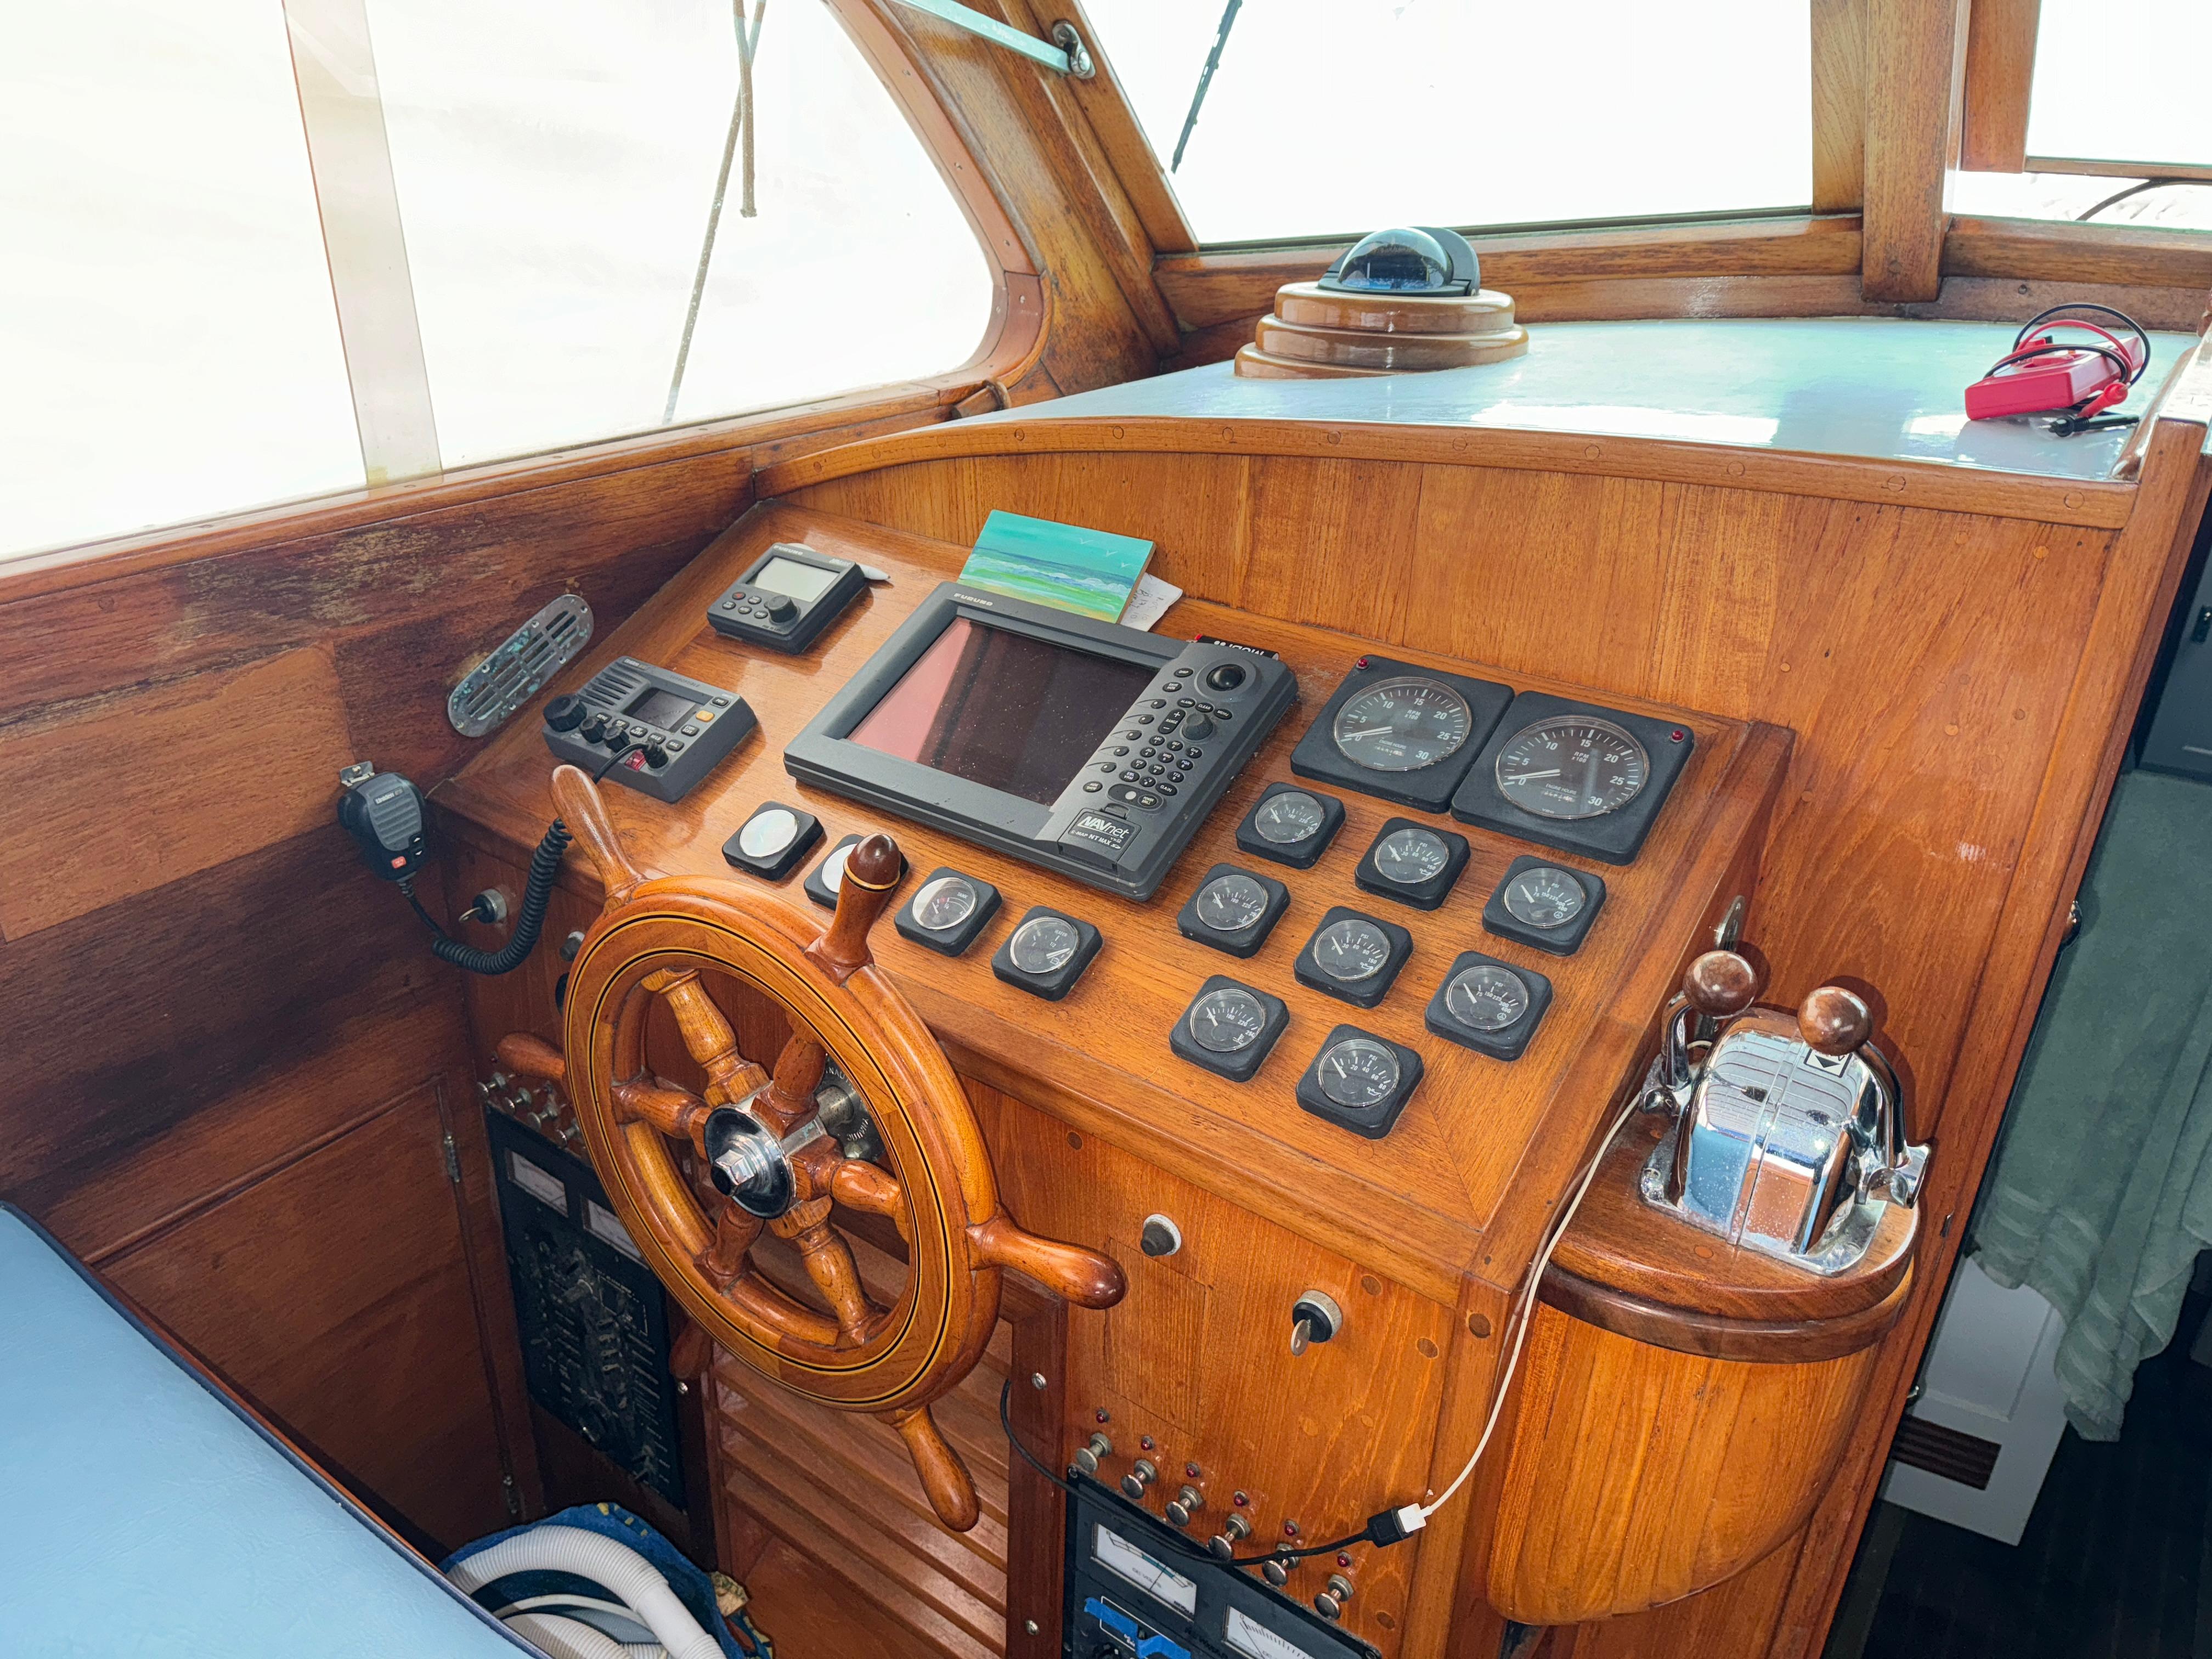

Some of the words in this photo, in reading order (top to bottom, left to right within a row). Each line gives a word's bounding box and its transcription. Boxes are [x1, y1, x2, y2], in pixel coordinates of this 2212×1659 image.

[953, 593, 993, 606] FURUNO
[1383, 701, 1394, 709] 10
[1414, 698, 1425, 706] 15
[1434, 711, 1447, 720] 20
[1437, 731, 1451, 740] 25
[1545, 741, 1558, 751] 10
[1580, 739, 1593, 747] 15
[1415, 750, 1429, 760] 30
[1604, 753, 1619, 764] 20
[1518, 777, 1526, 786] 0
[1610, 776, 1625, 786] 25
[1160, 785, 1172, 793] GAIN
[1588, 796, 1603, 806] 30
[1077, 815, 1130, 839] NAVnet
[1098, 837, 1112, 845] MAX
